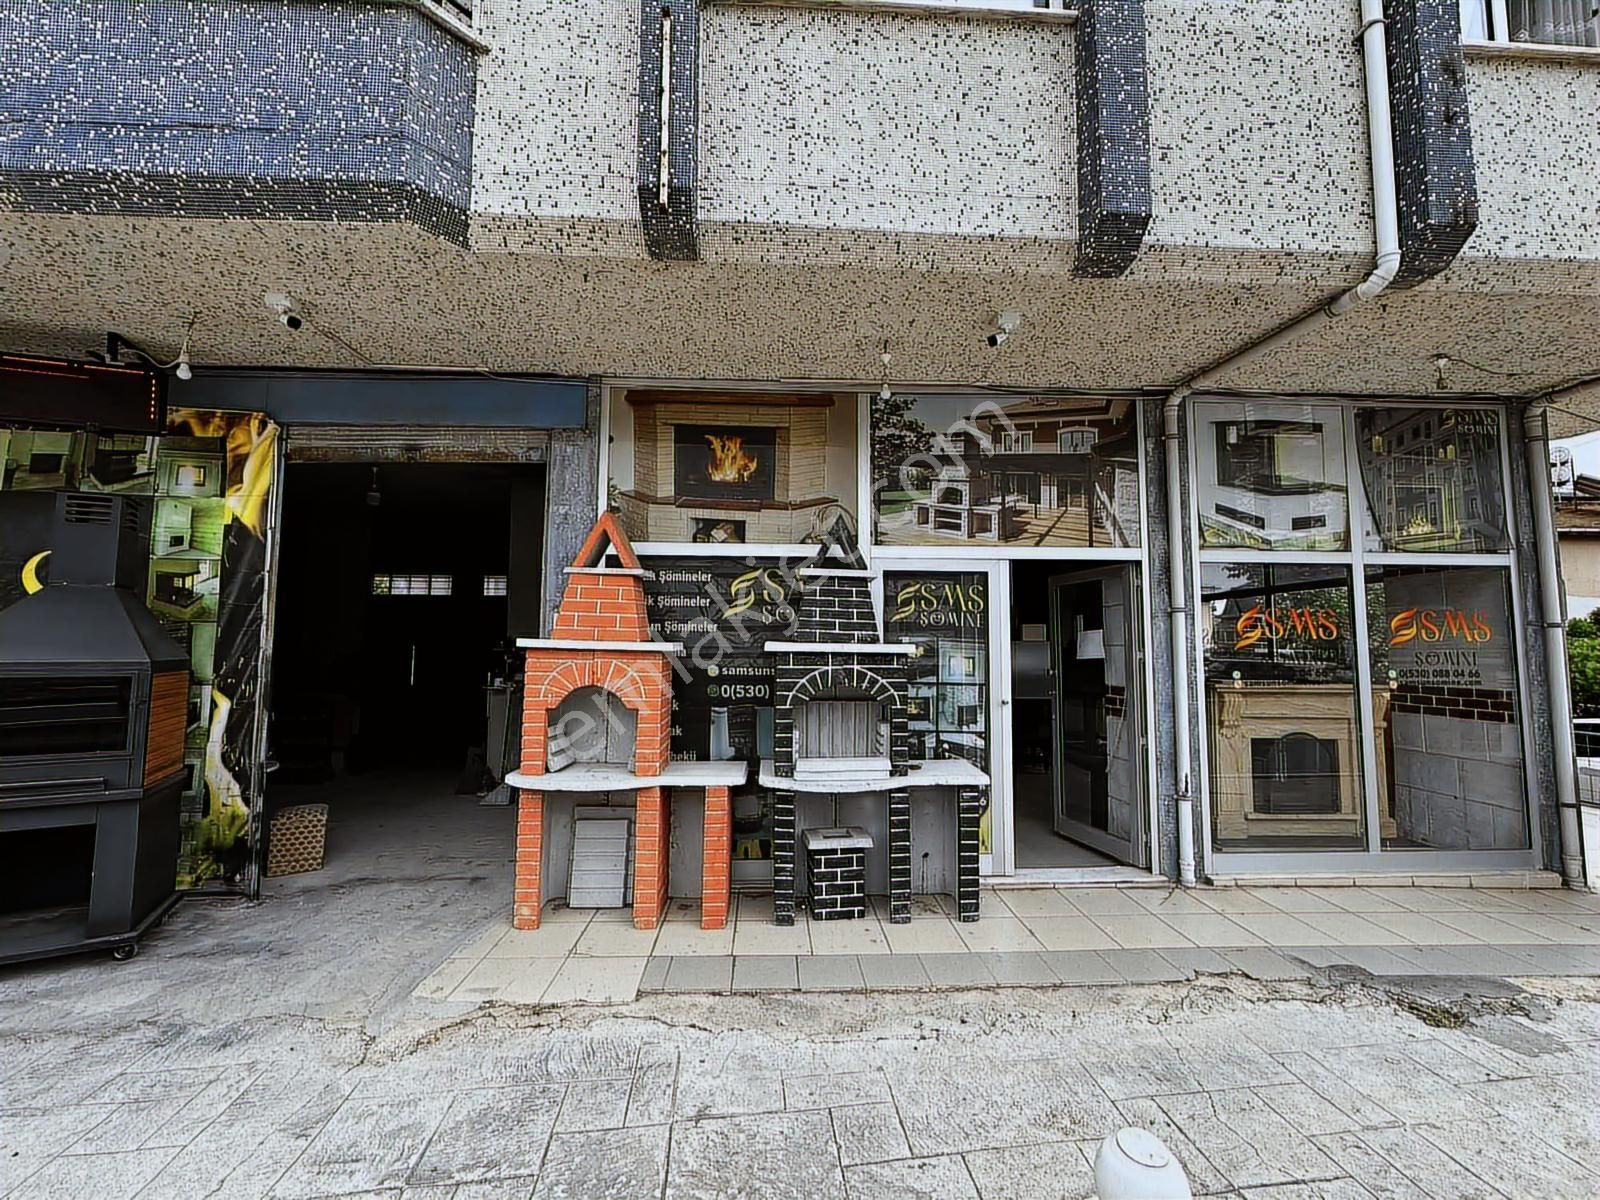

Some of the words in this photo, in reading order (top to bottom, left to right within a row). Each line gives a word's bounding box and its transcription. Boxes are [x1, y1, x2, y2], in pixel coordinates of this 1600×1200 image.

[659, 570, 712, 584] Şömineler
[658, 594, 711, 608] Şömineler
[921, 583, 984, 612] SMS
[664, 620, 718, 634] Şömineler
[1264, 607, 1338, 640] SMS
[1420, 608, 1492, 642] SMS
[1453, 669, 1466, 678] 04
[1468, 669, 1481, 679] 66
[721, 684, 770, 700] 0(530)
